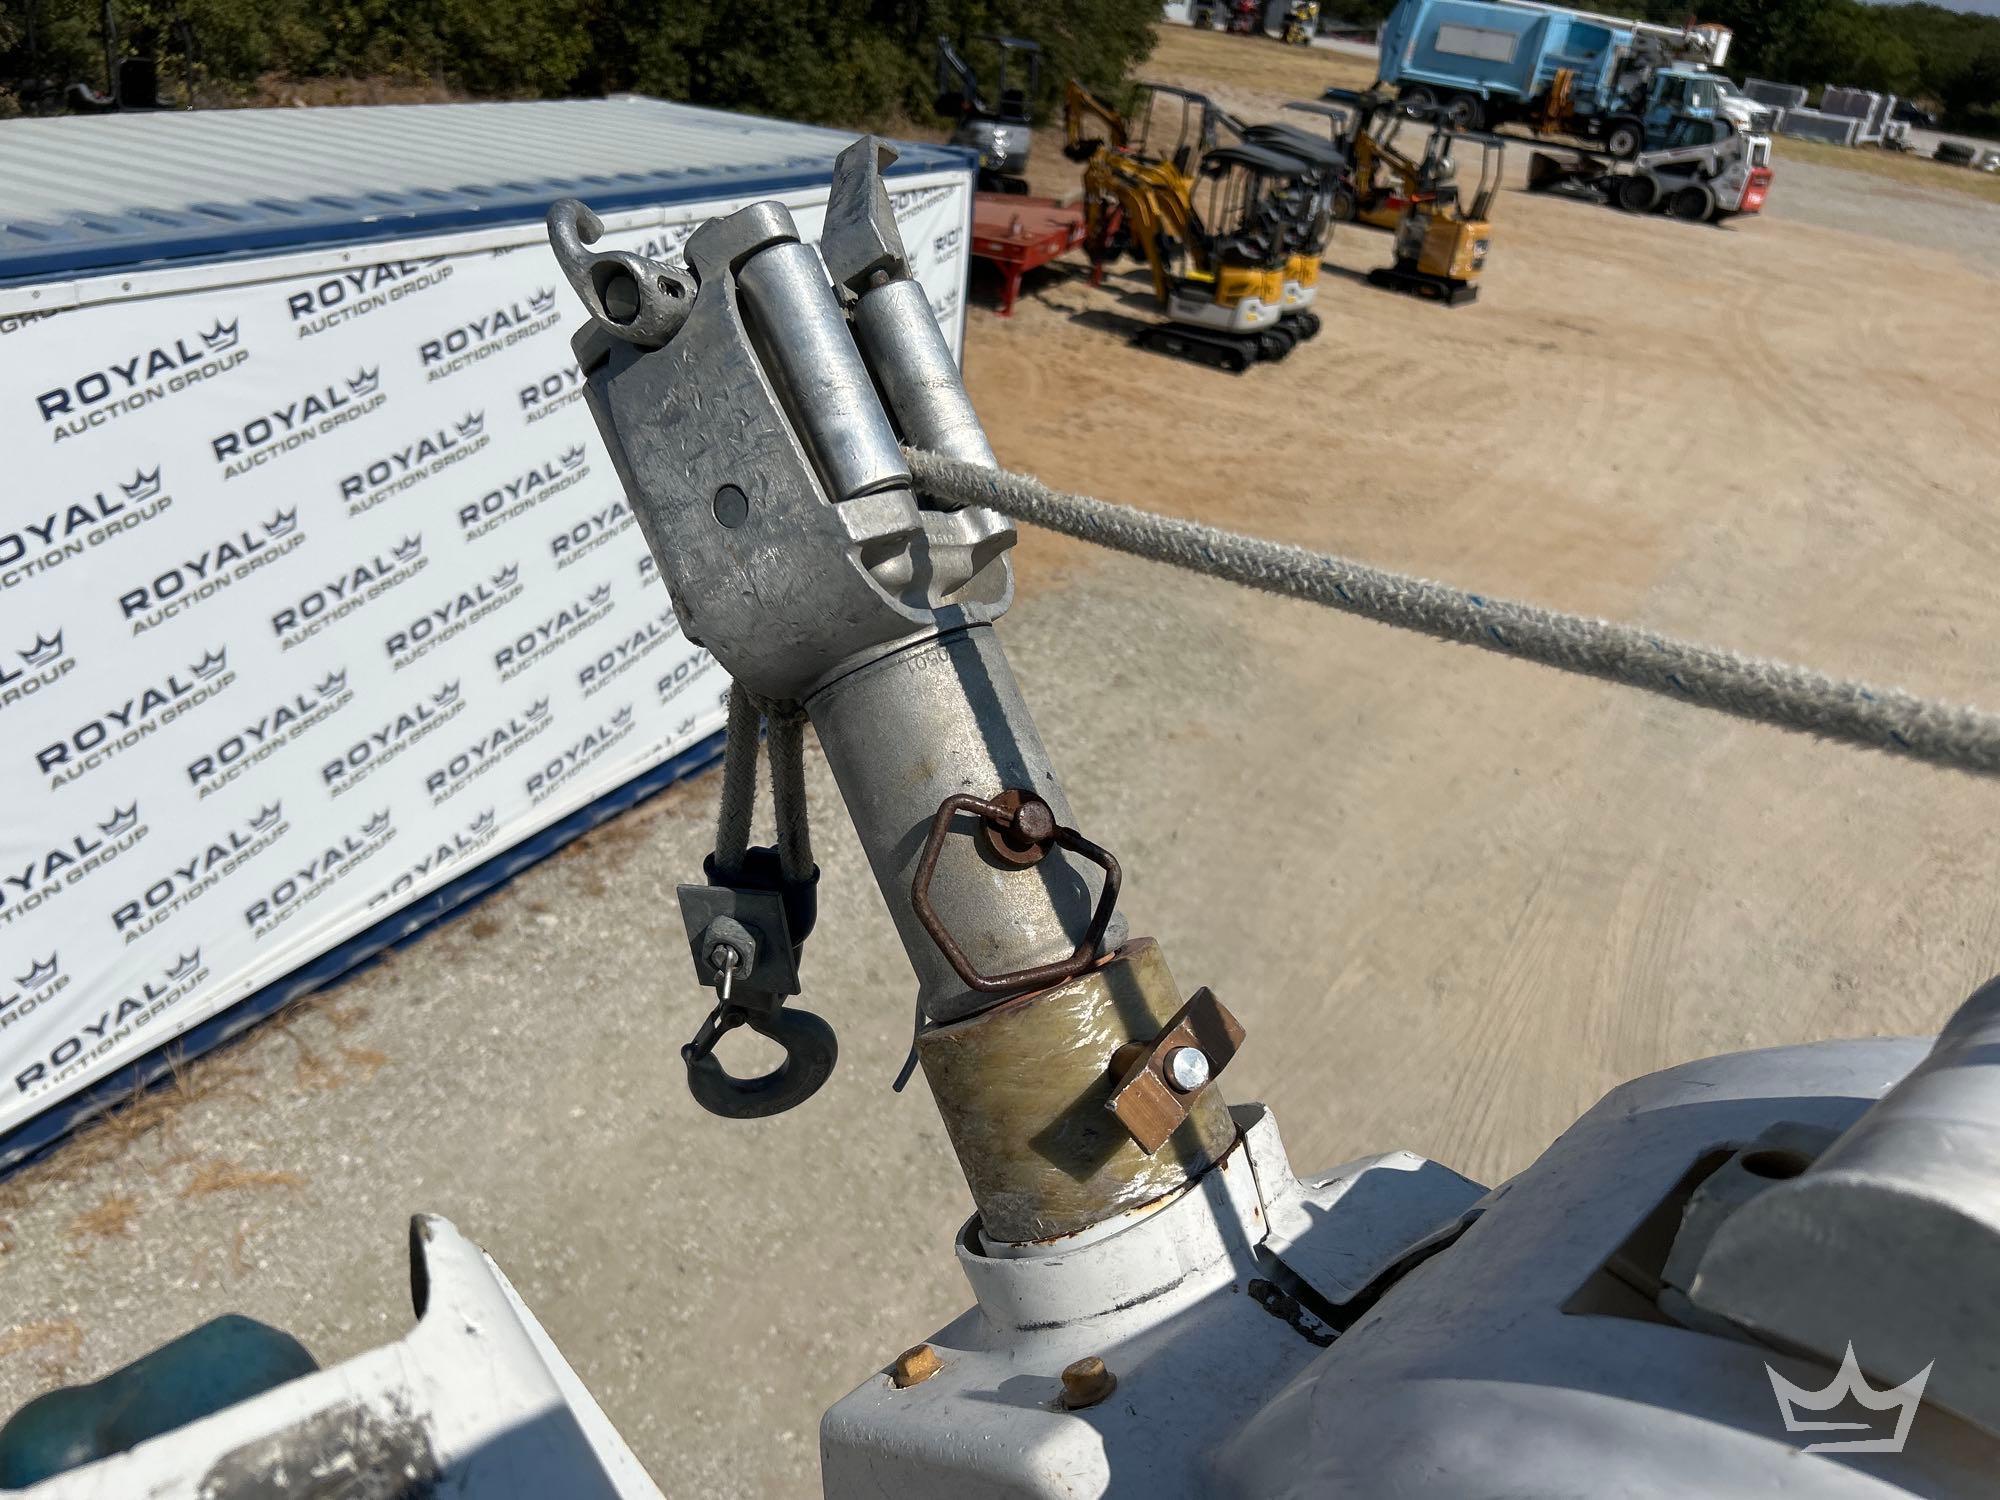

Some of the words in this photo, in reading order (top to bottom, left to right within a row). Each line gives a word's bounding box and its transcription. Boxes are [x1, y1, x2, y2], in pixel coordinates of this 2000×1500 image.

[287, 259, 419, 321] ROYAL
[298, 294, 387, 339] AUCTION
[390, 266, 454, 302] GROUP
[419, 302, 531, 367] ROYAL
[426, 335, 504, 383] AUCTION
[505, 310, 561, 346] GROUP
[36, 338, 203, 422] ROYAL
[53, 379, 164, 443] AUCTION
[168, 349, 250, 394] GROUP
[519, 363, 580, 410] ROY
[525, 389, 583, 426] AUCTIO
[211, 386, 349, 462] ROYAL
[224, 427, 317, 480] AUCTION
[319, 394, 387, 434] GROUP
[340, 431, 458, 501] ROYAL
[349, 465, 430, 518] AUCTION
[431, 435, 491, 474] GROUP
[459, 462, 563, 530] ROYAL
[465, 495, 537, 542] AUCTION
[538, 466, 591, 504] GROUP
[0, 492, 124, 567] OYAL
[0, 540, 83, 591] CTION
[87, 495, 172, 548] GROUP
[551, 501, 634, 558] ROYA
[557, 526, 618, 570] AUCTION
[118, 530, 266, 619] ROYAL
[133, 574, 232, 638] AUCTION
[234, 533, 305, 581] GROUP
[271, 555, 395, 636] ROYAL
[281, 596, 365, 652] AUCTION
[367, 555, 428, 599] GROUP
[385, 581, 493, 658] ROYAL
[393, 621, 468, 673] AUCTION
[469, 584, 524, 624] GROUP
[495, 602, 589, 671] ROYAL
[501, 637, 567, 683] AUCTION
[567, 602, 615, 640] GROUP
[579, 621, 660, 687] ROYAL
[0, 657, 76, 706] ROUP
[584, 654, 640, 699] AUCTION
[35, 675, 194, 774] ROYAL
[51, 719, 157, 791] AUCTION
[160, 670, 237, 723] GROUP
[187, 695, 318, 786] ROYAL
[199, 733, 287, 799] AUCTION
[289, 689, 353, 738] GROUP
[322, 703, 435, 785] ROYAL
[330, 740, 406, 797] AUCTION
[407, 700, 466, 744] GROUP
[425, 719, 527, 795] ROYAL
[433, 753, 503, 808] AUCTION
[504, 714, 553, 755] GROUP
[526, 727, 613, 795] ROYAL
[532, 756, 590, 803] AUCTION
[591, 720, 635, 761] GROUP
[0, 835, 103, 906] YAL
[0, 881, 62, 923] TION
[66, 824, 148, 884] GROUP
[111, 831, 251, 931] ROYAL
[125, 872, 220, 945] AUCTION
[222, 821, 290, 878] GROUP
[244, 835, 364, 927] ROYAL
[255, 872, 335, 939] AUCTION
[337, 826, 396, 877] GROUP
[0, 975, 70, 1030] ROUP
[15, 983, 167, 1092] ROYAL
[135, 967, 209, 1028] GROUP
